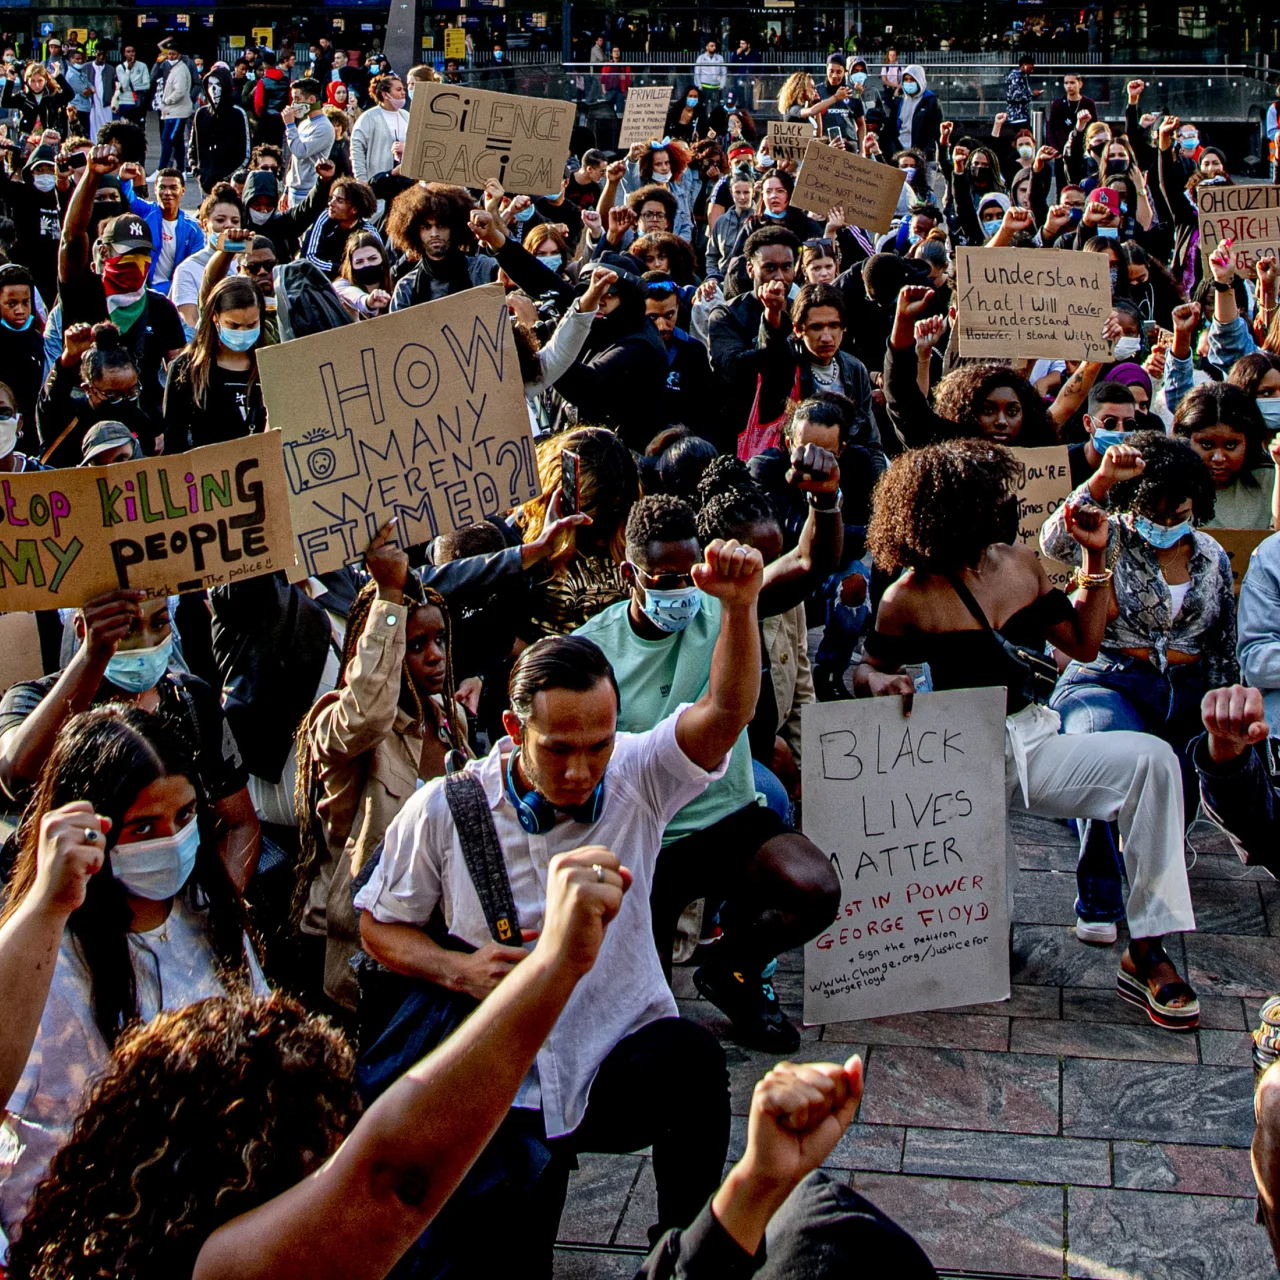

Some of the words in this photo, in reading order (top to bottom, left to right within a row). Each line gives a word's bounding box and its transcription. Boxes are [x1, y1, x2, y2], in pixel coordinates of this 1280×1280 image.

[773, 124, 803, 136] BLACK
[773, 136, 800, 147] LIVES
[1200, 191, 1225, 213] OH
[1227, 188, 1263, 211] CUZ
[130, 222, 143, 236] NY
[1202, 220, 1219, 246] A
[1217, 216, 1269, 241] BITCH
[965, 254, 971, 284] I
[984, 262, 1101, 290] understand
[960, 286, 1013, 311] That
[1019, 294, 1023, 311] I
[1067, 302, 1103, 317] never
[988, 312, 1070, 327] understand
[1018, 329, 1021, 340] I
[1026, 328, 1058, 340] stand
[1083, 340, 1113, 359] you!
[319, 304, 508, 440] HOW
[359, 393, 487, 483] MANY
[312, 436, 495, 524] WERENT
[820, 724, 965, 781] BLACK
[862, 789, 973, 837] LIVES
[872, 892, 892, 910] IN
[906, 875, 984, 904] POWER
[816, 916, 905, 950] GEORGE
[883, 940, 906, 953] the
